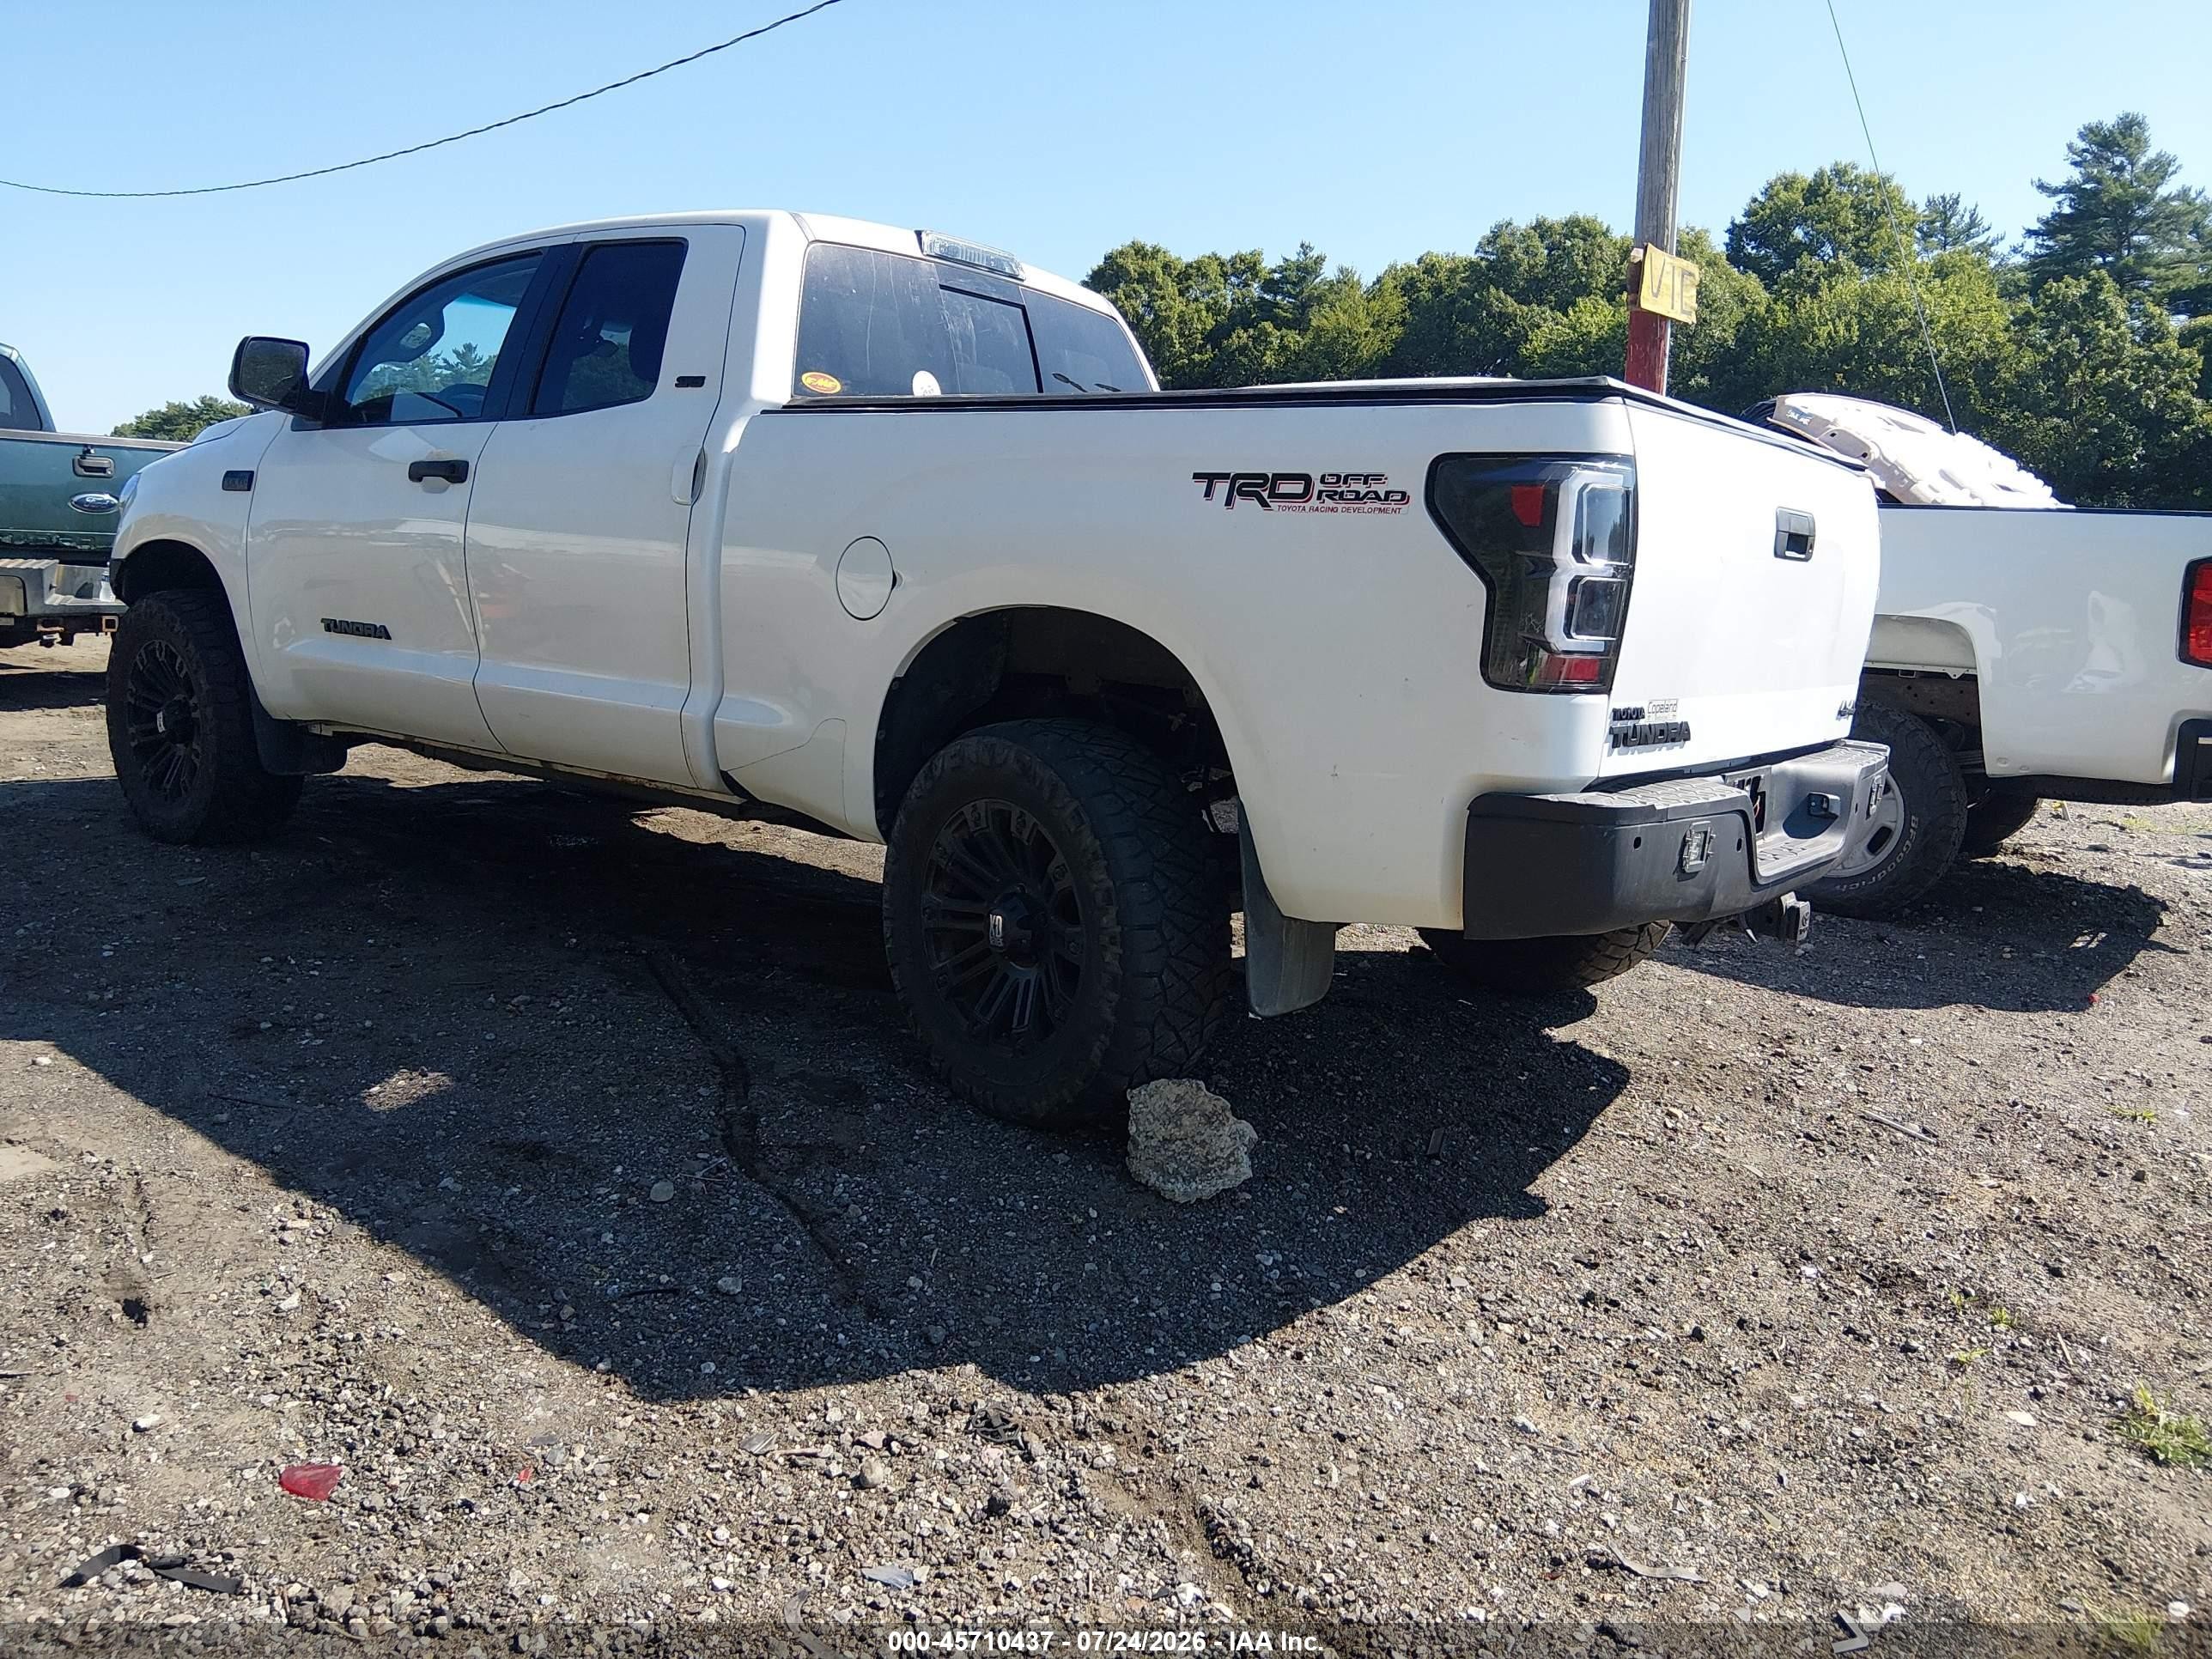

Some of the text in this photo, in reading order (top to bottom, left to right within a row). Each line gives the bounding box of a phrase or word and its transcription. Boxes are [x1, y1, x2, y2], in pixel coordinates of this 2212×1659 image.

[1192, 472, 1315, 510] TRD
[1318, 473, 1389, 489] OFF
[1316, 489, 1411, 505] ROAD
[1277, 505, 1403, 515] TOYOTA RACING DEVELOPMENT
[320, 617, 392, 641] TUNDRA
[1609, 721, 1691, 749] TUNDRA
